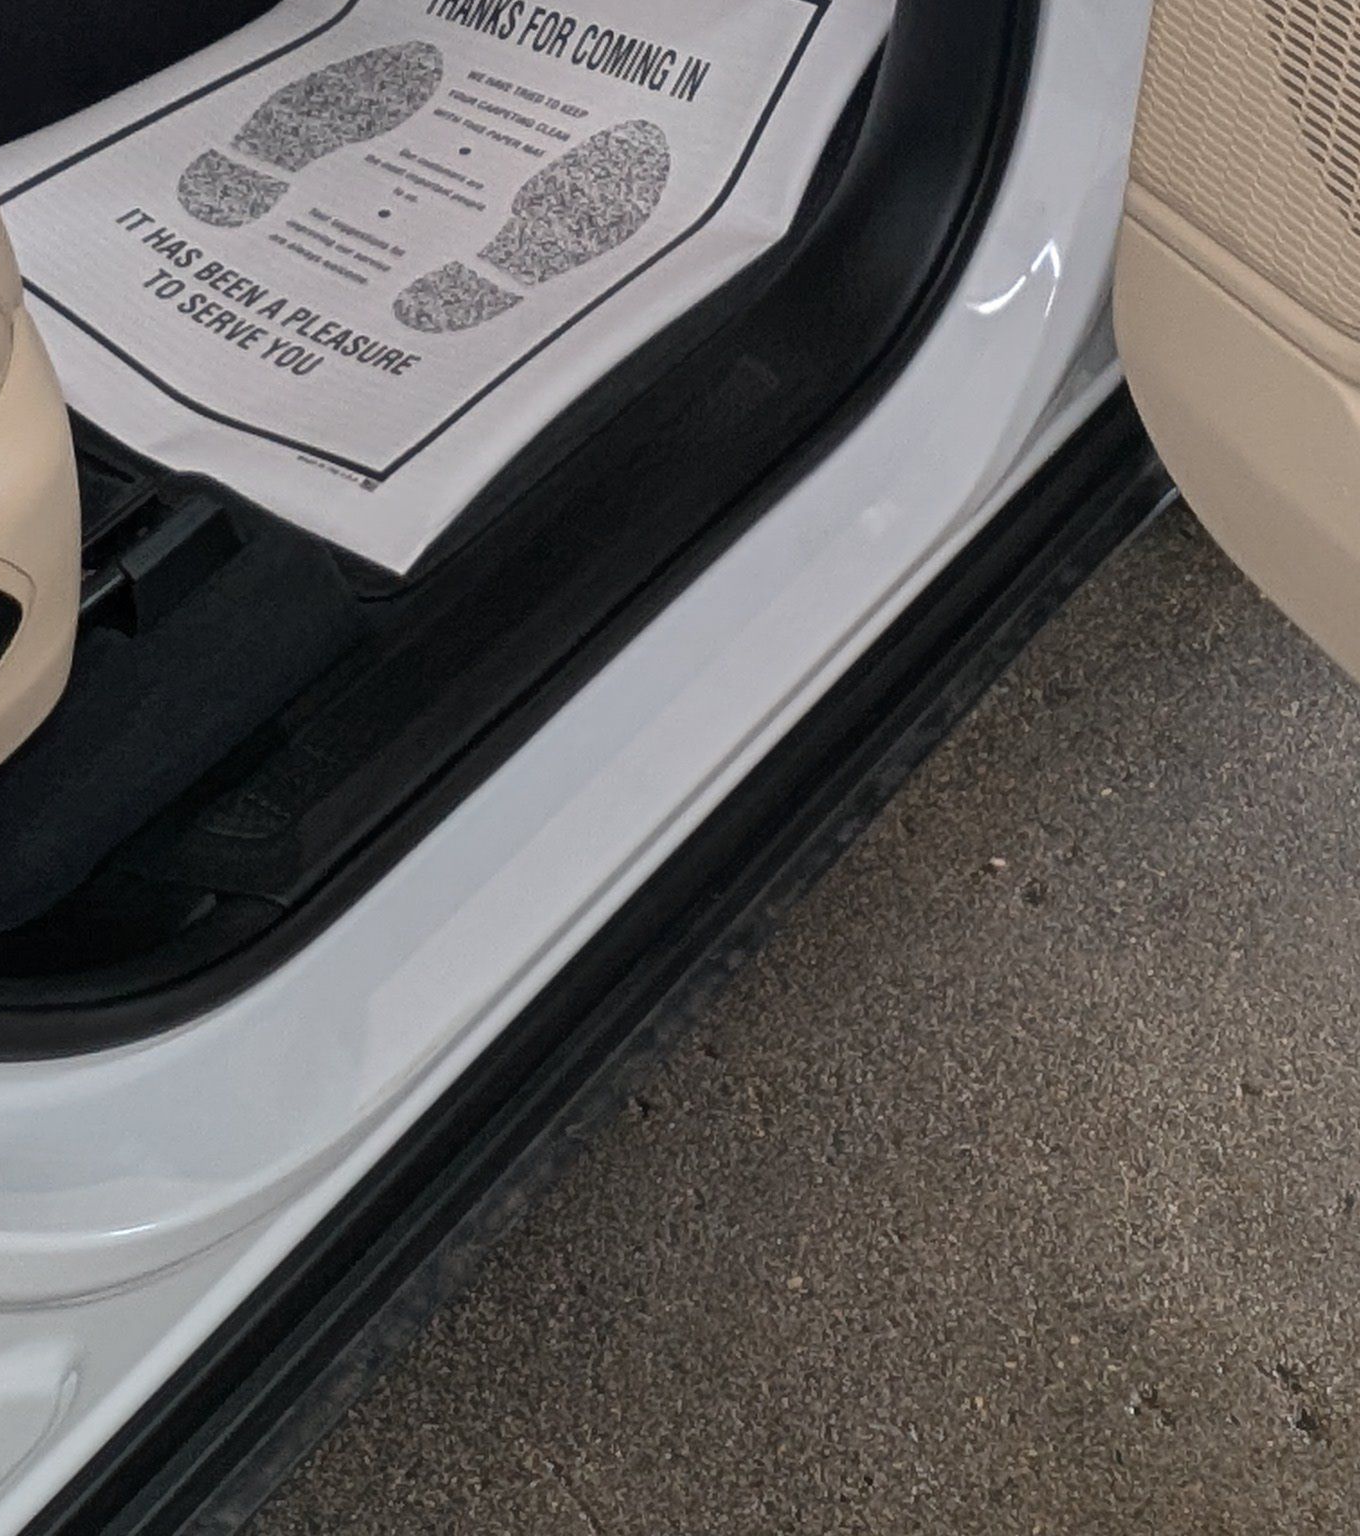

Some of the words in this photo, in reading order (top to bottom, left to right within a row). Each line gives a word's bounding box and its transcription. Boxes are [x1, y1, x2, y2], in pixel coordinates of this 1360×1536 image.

[517, 6, 577, 58] FOR
[571, 24, 677, 91] COMING
[669, 56, 711, 102] IN
[116, 208, 156, 231] IT
[142, 227, 203, 268] HAS
[193, 261, 269, 308] BEEN
[258, 298, 288, 320] A
[281, 307, 422, 376] PLEASURE
[143, 268, 186, 300] TO
[177, 292, 270, 351] SERVE
[260, 337, 325, 376] YOU
